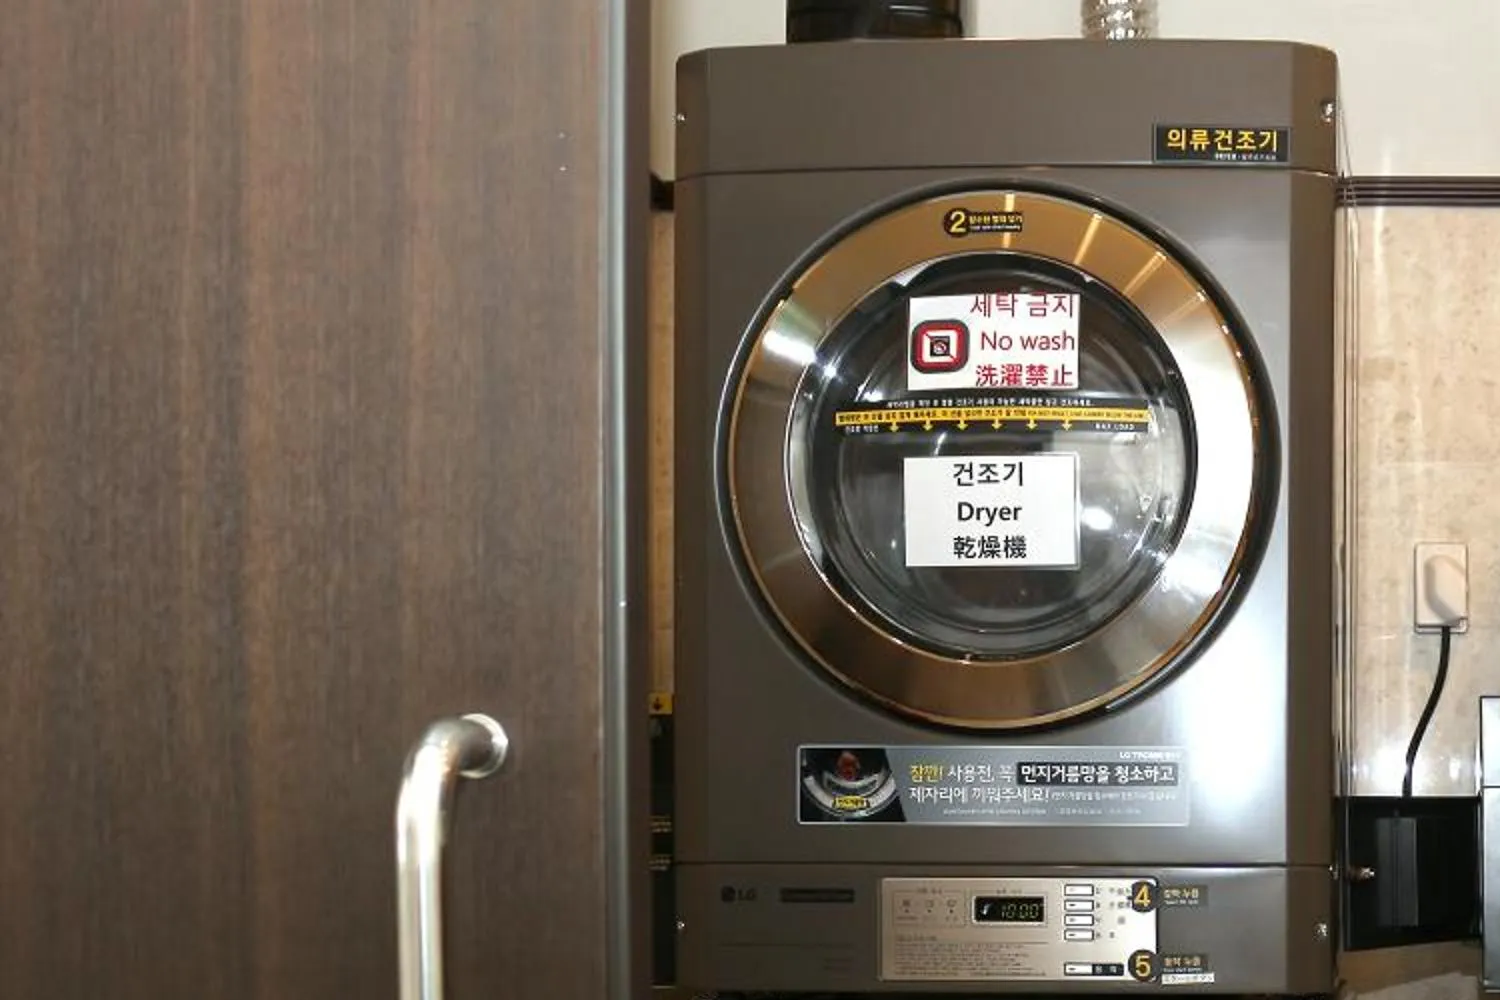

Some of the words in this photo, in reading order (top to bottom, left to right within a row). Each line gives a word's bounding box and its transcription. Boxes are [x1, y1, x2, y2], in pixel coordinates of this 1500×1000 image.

[1167, 129, 1278, 152] 의류건조기
[950, 211, 966, 232] 2
[970, 292, 1019, 318] 세탁
[1026, 291, 1074, 318] 금지
[981, 331, 1012, 351] No
[1021, 330, 1075, 351] wash
[975, 363, 1073, 387] 洗濯禁止
[953, 461, 1024, 487] 건조기
[957, 501, 1022, 526] Dryer
[953, 535, 1027, 559] 乾燥機
[1134, 885, 1151, 907] 4
[1135, 955, 1150, 978] 5
